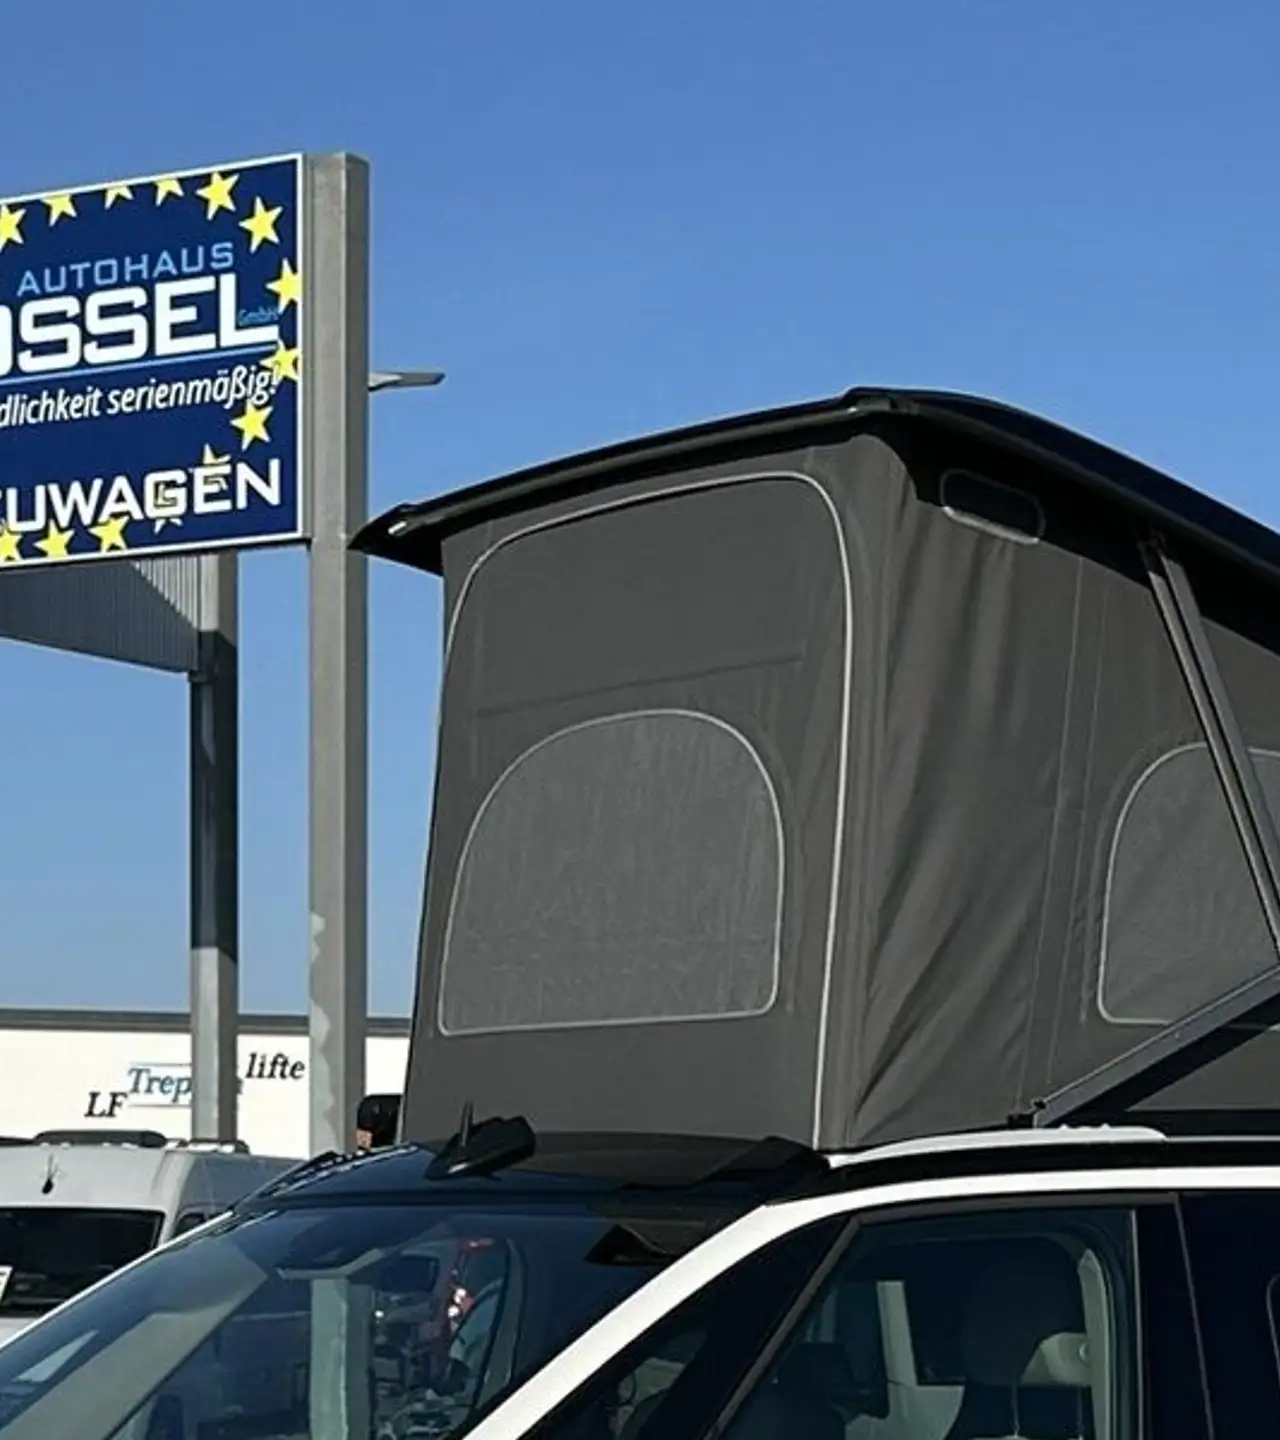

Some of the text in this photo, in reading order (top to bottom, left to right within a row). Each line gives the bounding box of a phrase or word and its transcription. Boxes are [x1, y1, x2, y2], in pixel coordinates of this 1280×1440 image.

[16, 242, 235, 297] AUTOHAUS
[106, 362, 282, 416] serienmäßig!
[84, 1091, 129, 1118] LF
[245, 1053, 306, 1080] lifte
